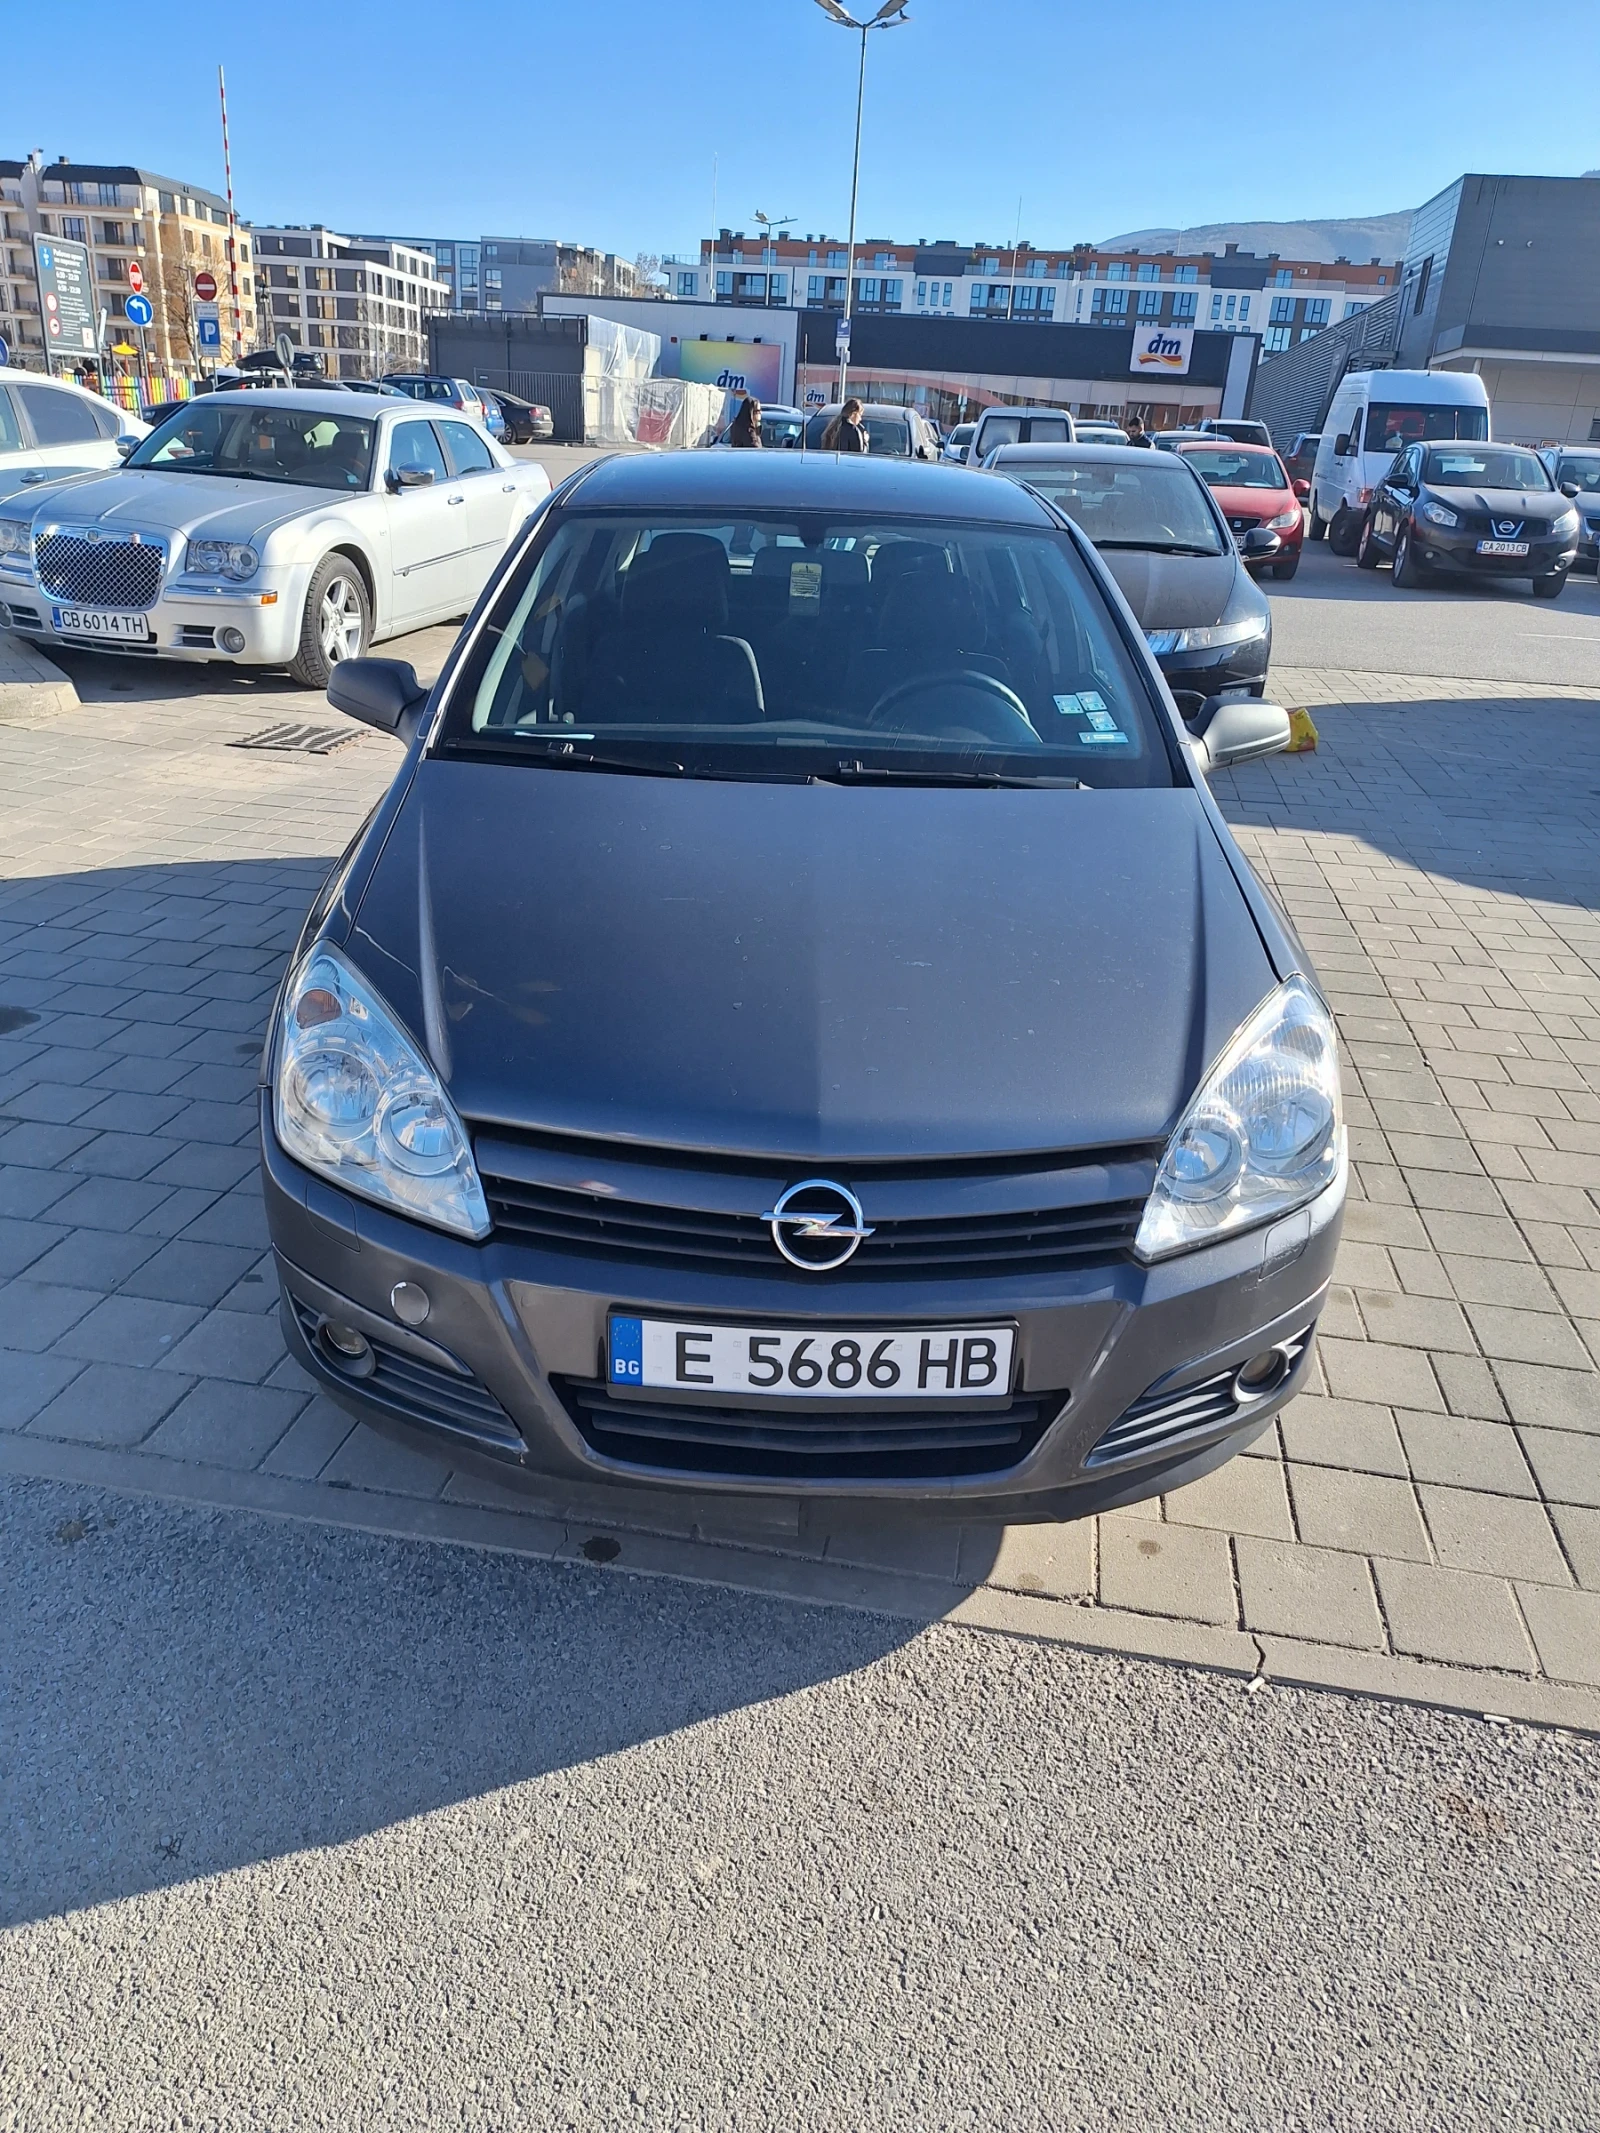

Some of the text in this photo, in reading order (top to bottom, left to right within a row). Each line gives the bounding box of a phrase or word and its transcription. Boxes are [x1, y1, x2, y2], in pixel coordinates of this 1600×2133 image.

[204, 322, 216, 342] P
[1148, 333, 1181, 355] dm
[717, 369, 745, 389] dm
[806, 389, 825, 403] dm
[1482, 542, 1527, 553] CA 2013 CB
[62, 611, 81, 628] CB
[83, 613, 119, 631] 6014
[121, 616, 144, 633] TH
[615, 1358, 640, 1375] BG
[676, 1332, 997, 1389] E 5686 HB
